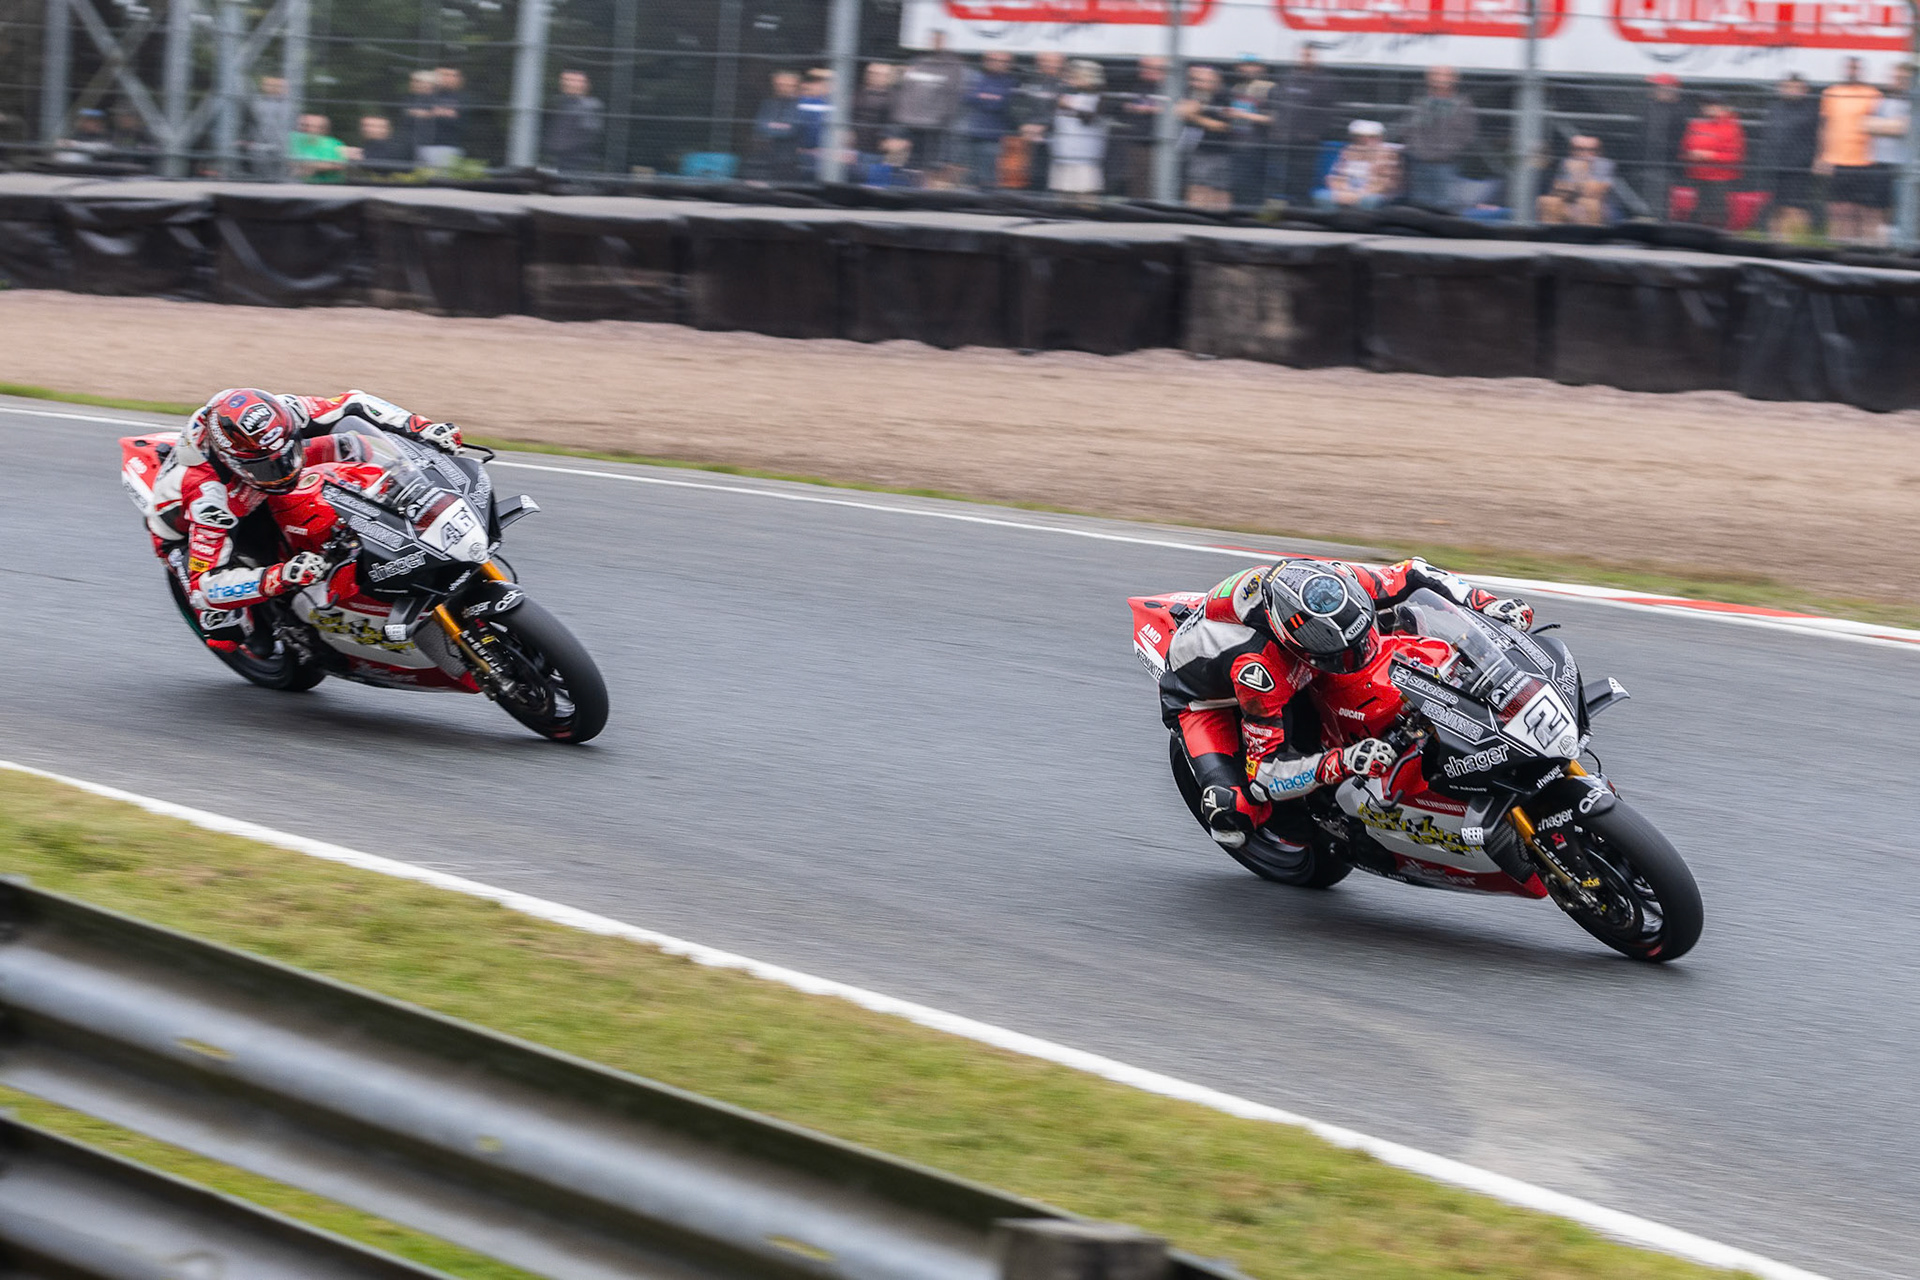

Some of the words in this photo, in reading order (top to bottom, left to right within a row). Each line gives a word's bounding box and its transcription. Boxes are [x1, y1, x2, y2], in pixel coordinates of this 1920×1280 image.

[1141, 623, 1162, 645] AMD
[1408, 675, 1459, 705] Silkolene
[1338, 707, 1366, 721] DUCATI
[1524, 694, 1570, 750] 2
[1461, 827, 1484, 841] BEER
